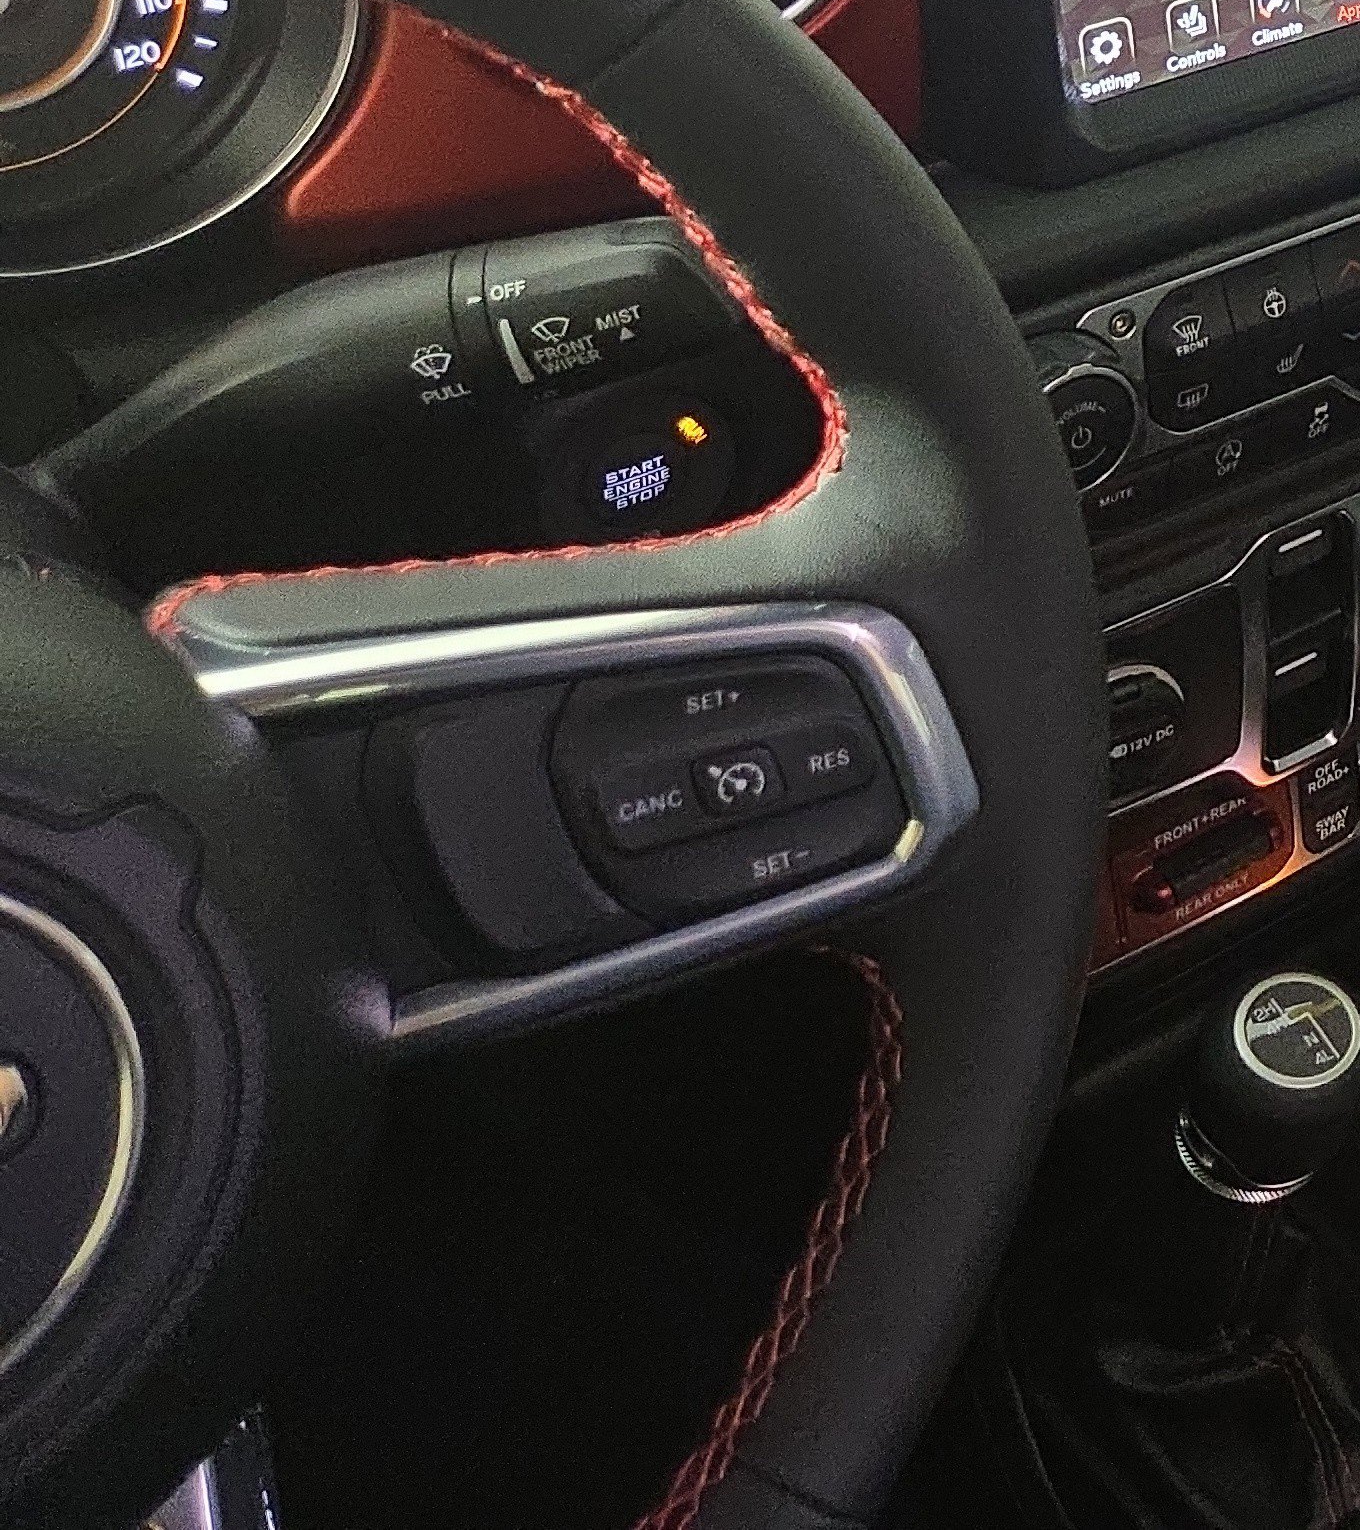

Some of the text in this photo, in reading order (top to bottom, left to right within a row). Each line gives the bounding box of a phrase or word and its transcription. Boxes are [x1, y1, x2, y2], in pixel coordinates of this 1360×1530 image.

[1251, 20, 1304, 47] Climate
[113, 40, 161, 72] 120
[1166, 41, 1227, 73] Controls
[1080, 69, 1141, 99] Settings
[490, 280, 526, 302] OFF
[595, 305, 641, 331] MIST
[533, 335, 594, 361] FRONT
[1175, 336, 1210, 357] FRONT
[540, 350, 602, 374] WIPER
[421, 382, 472, 405] PULL
[605, 455, 664, 483] START
[603, 468, 671, 500] ENGINE
[616, 483, 666, 510] STOP
[1099, 486, 1134, 507] MUTE
[1129, 724, 1175, 753] 12V DC
[809, 748, 850, 774] RES
[1315, 759, 1340, 778] OFF
[1308, 766, 1350, 794] ROAD+
[618, 789, 683, 820] CANC
[1315, 806, 1350, 831] SWAY
[1319, 820, 1346, 841] BAR
[1175, 893, 1212, 921] REAR
